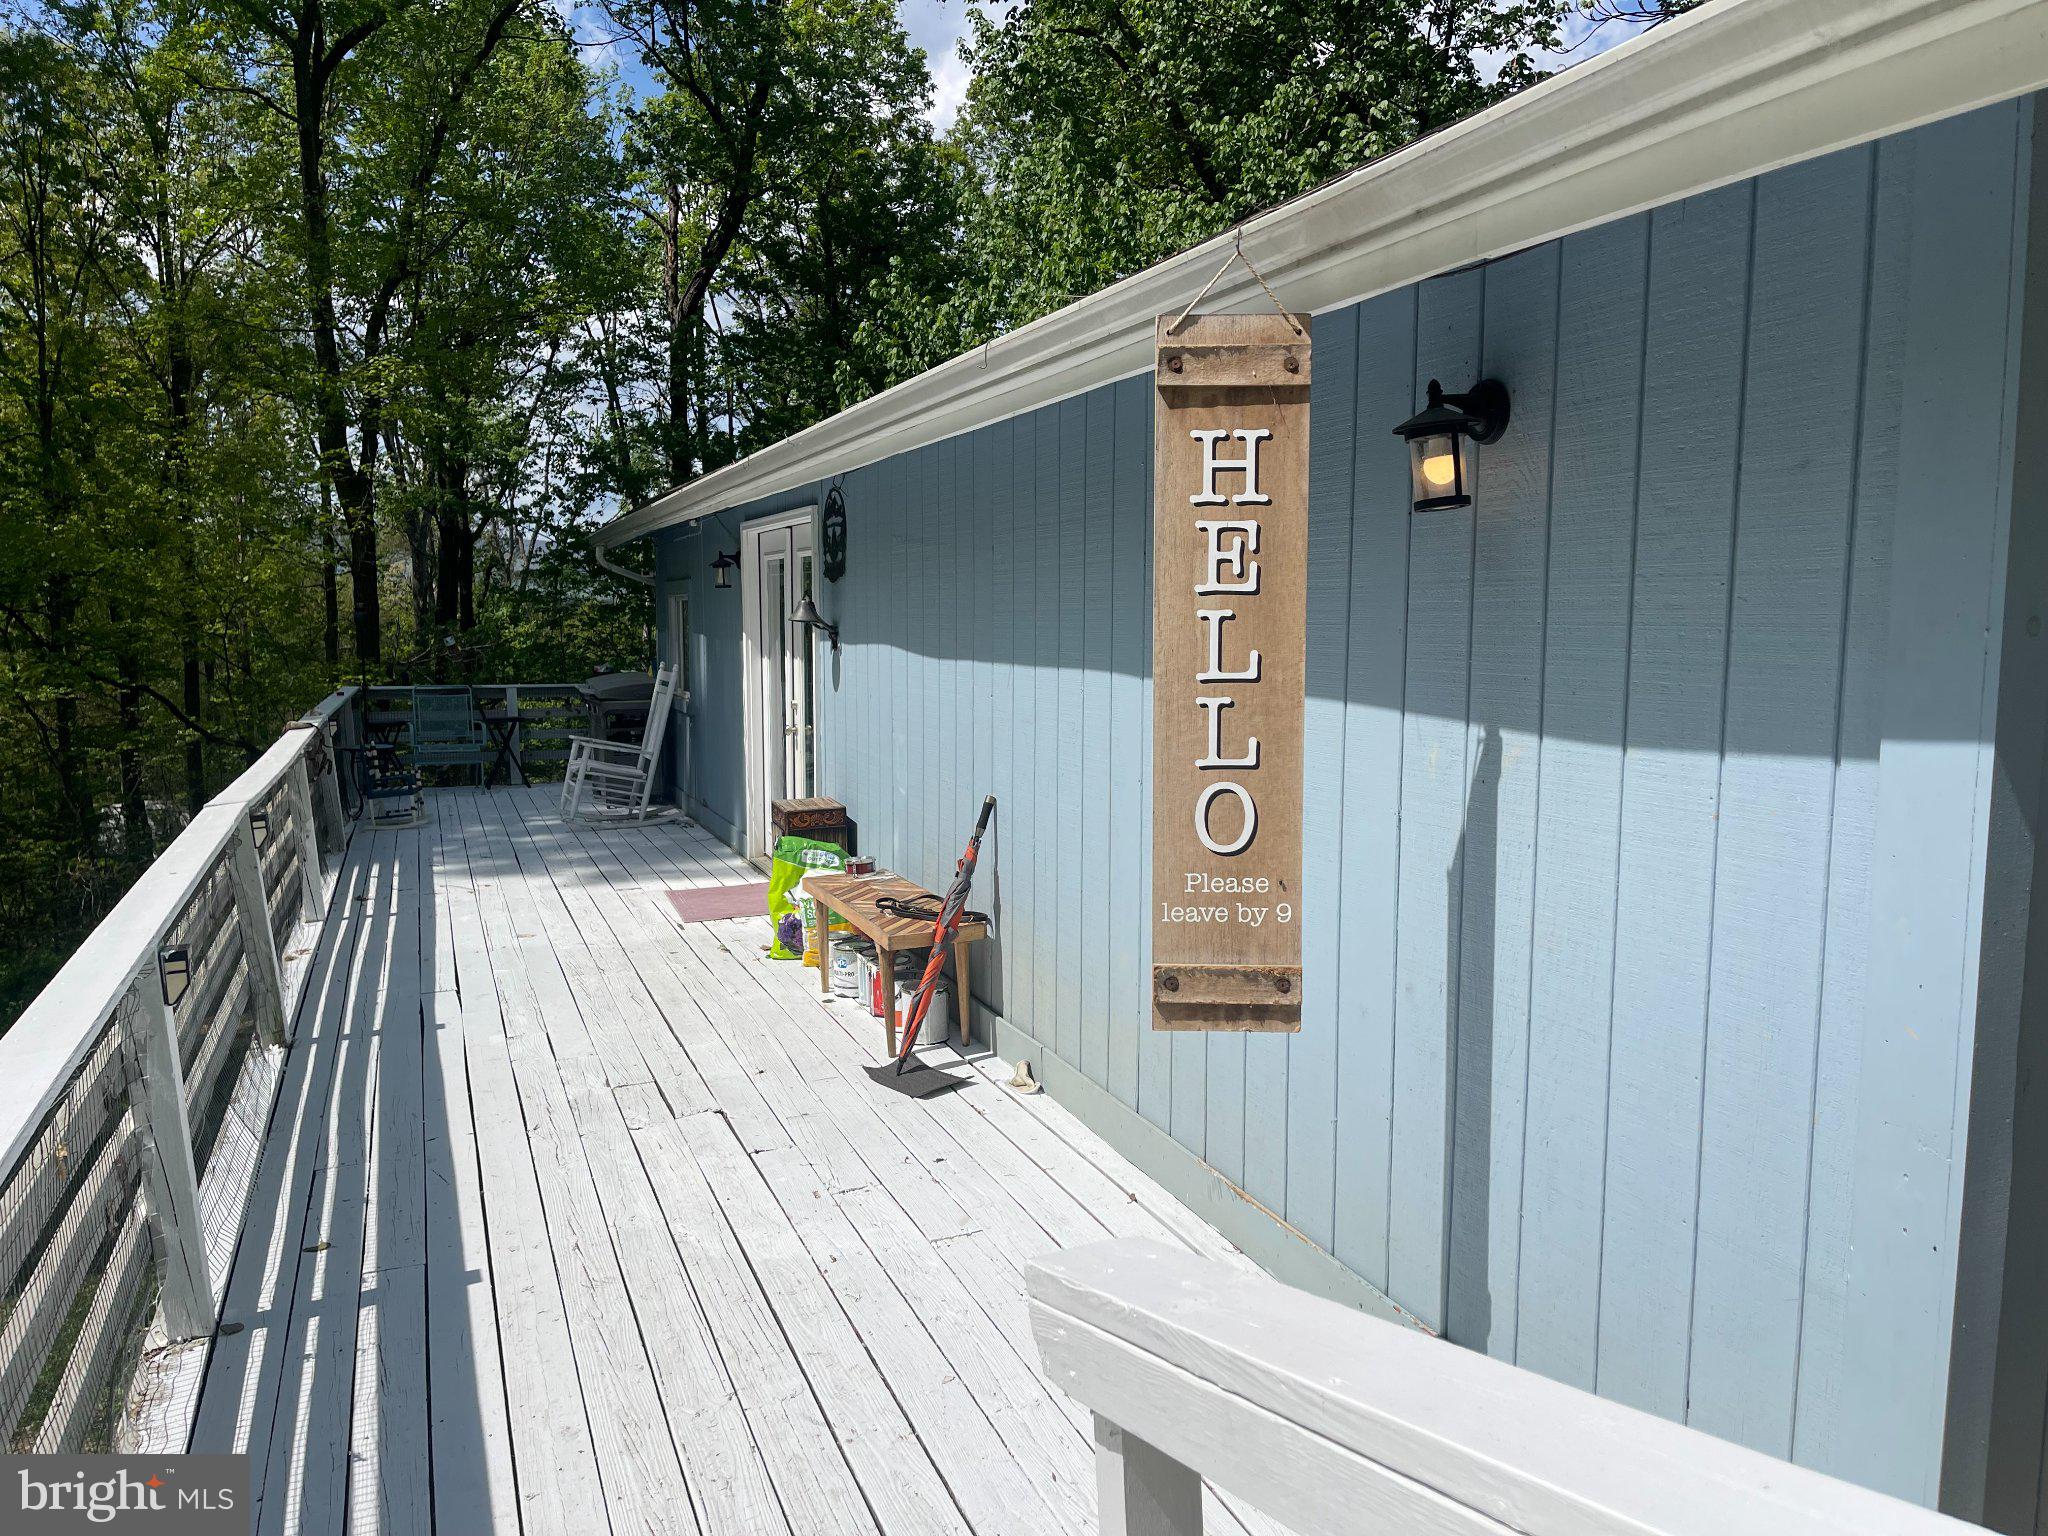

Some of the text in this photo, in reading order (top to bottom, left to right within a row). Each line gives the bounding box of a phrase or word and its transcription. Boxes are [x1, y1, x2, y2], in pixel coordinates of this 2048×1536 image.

[1189, 428, 1273, 857] HELLO
[1184, 872, 1270, 894] Please
[1161, 902, 1292, 927] leave by 9
